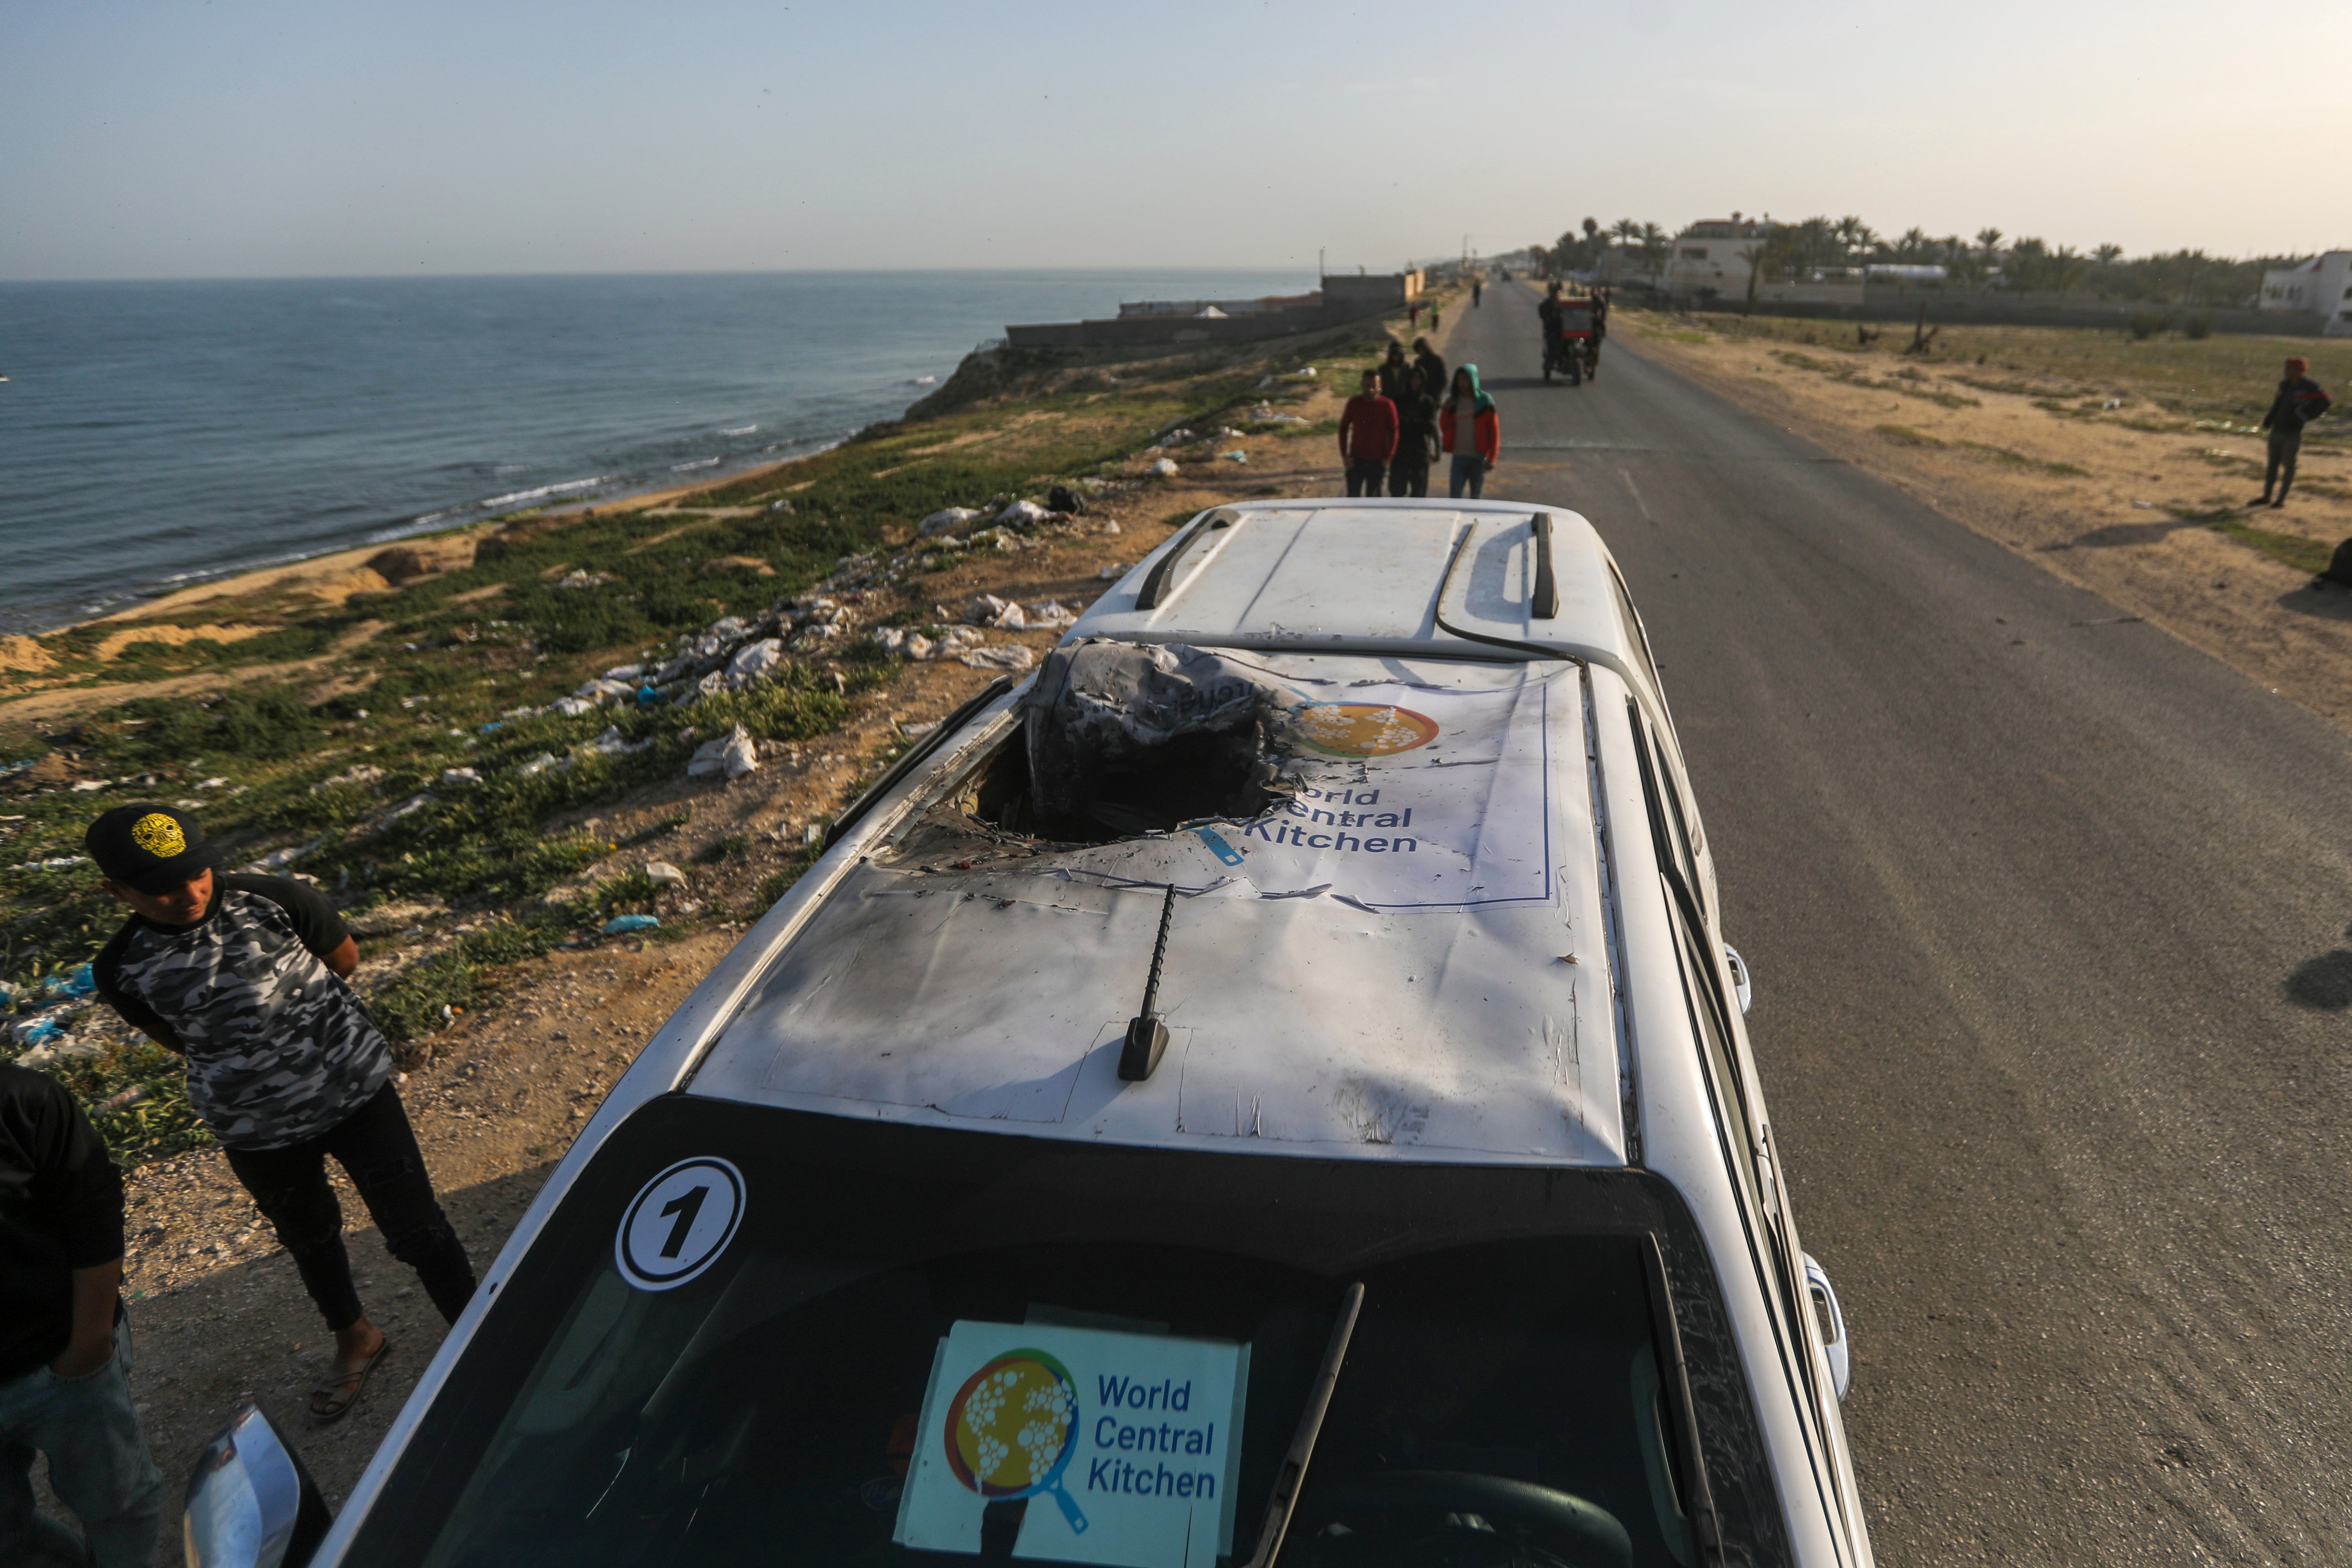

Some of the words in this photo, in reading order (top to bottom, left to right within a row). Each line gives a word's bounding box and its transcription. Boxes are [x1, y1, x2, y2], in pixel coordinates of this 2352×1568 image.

[1272, 801, 1412, 827] entral
[1304, 788, 1380, 805] orld
[1244, 818, 1417, 852] Kitchen
[660, 1185, 710, 1259] 1
[1098, 1373, 1192, 1412] World
[1094, 1415, 1214, 1456] Central
[1087, 1456, 1216, 1500] Kitchen
